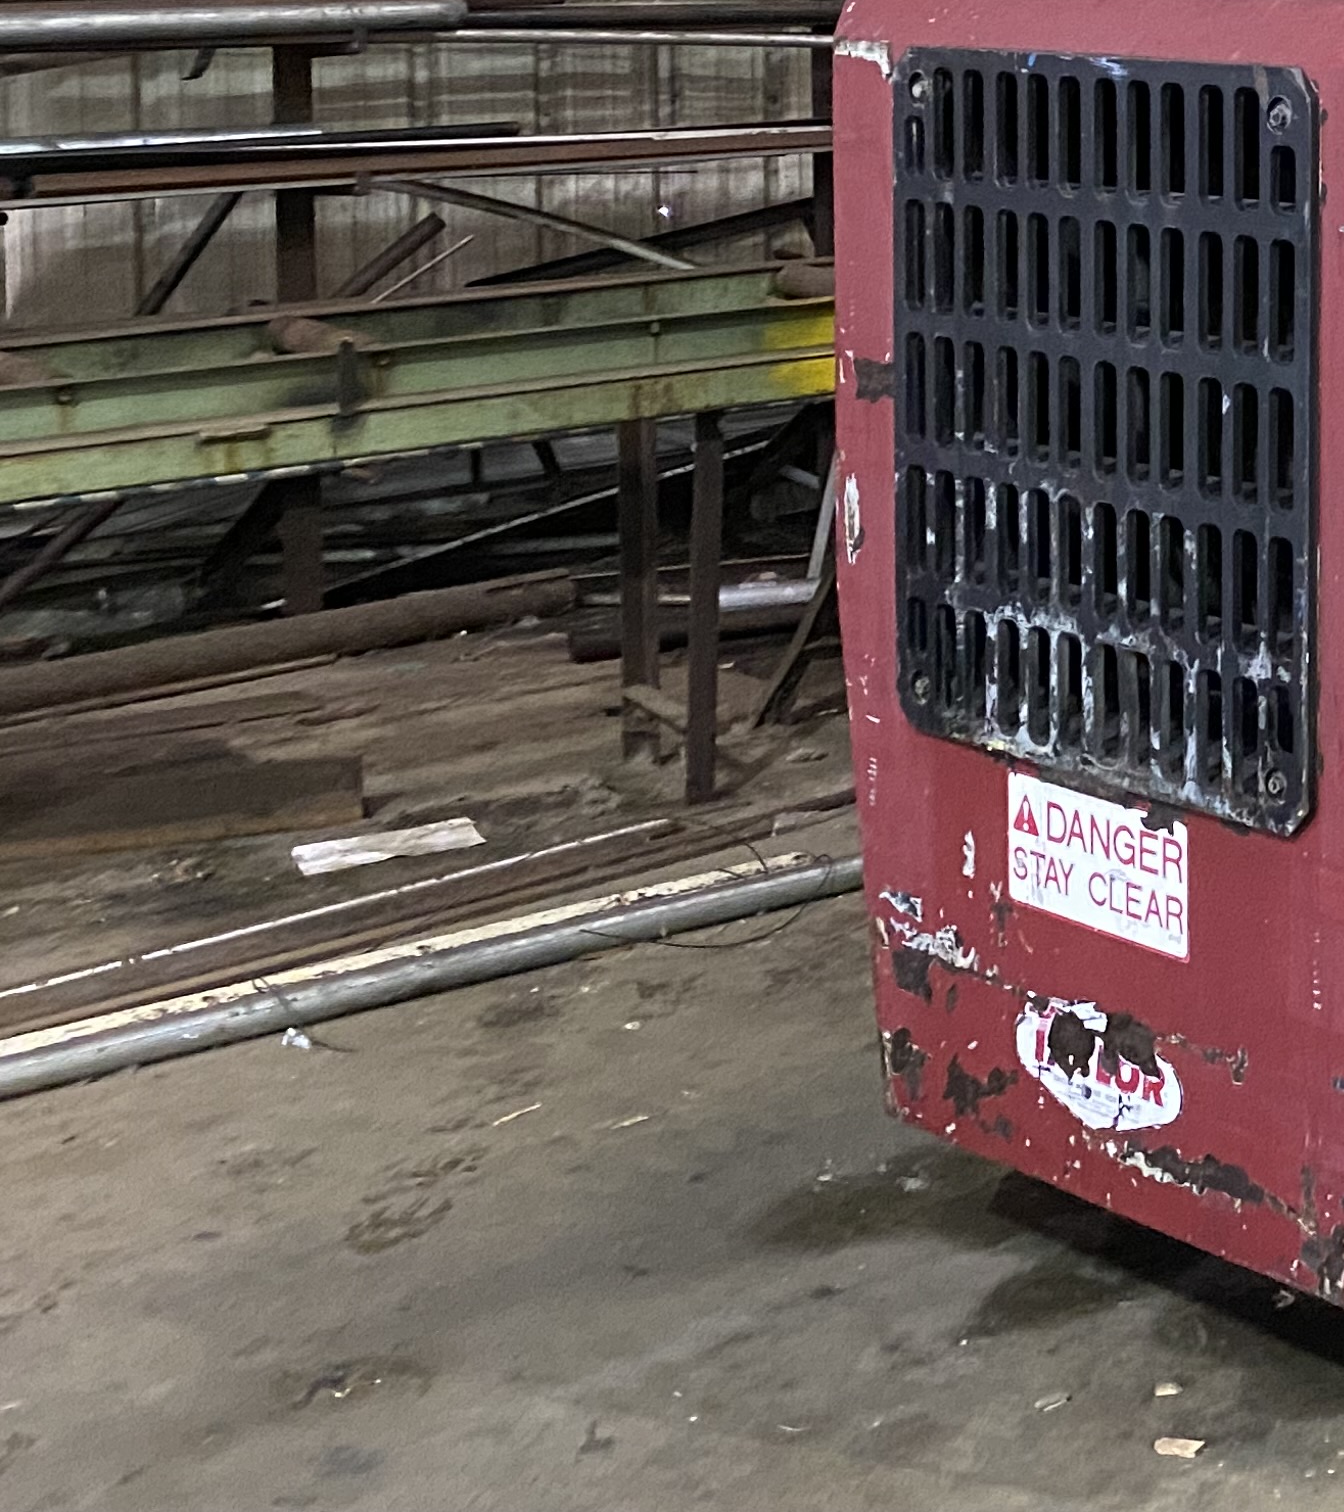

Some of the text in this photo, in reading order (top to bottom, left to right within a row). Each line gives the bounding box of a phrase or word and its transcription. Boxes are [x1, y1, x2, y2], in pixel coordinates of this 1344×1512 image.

[1047, 800, 1183, 884] DANGER
[1013, 846, 1183, 935] STAY CLEAR
